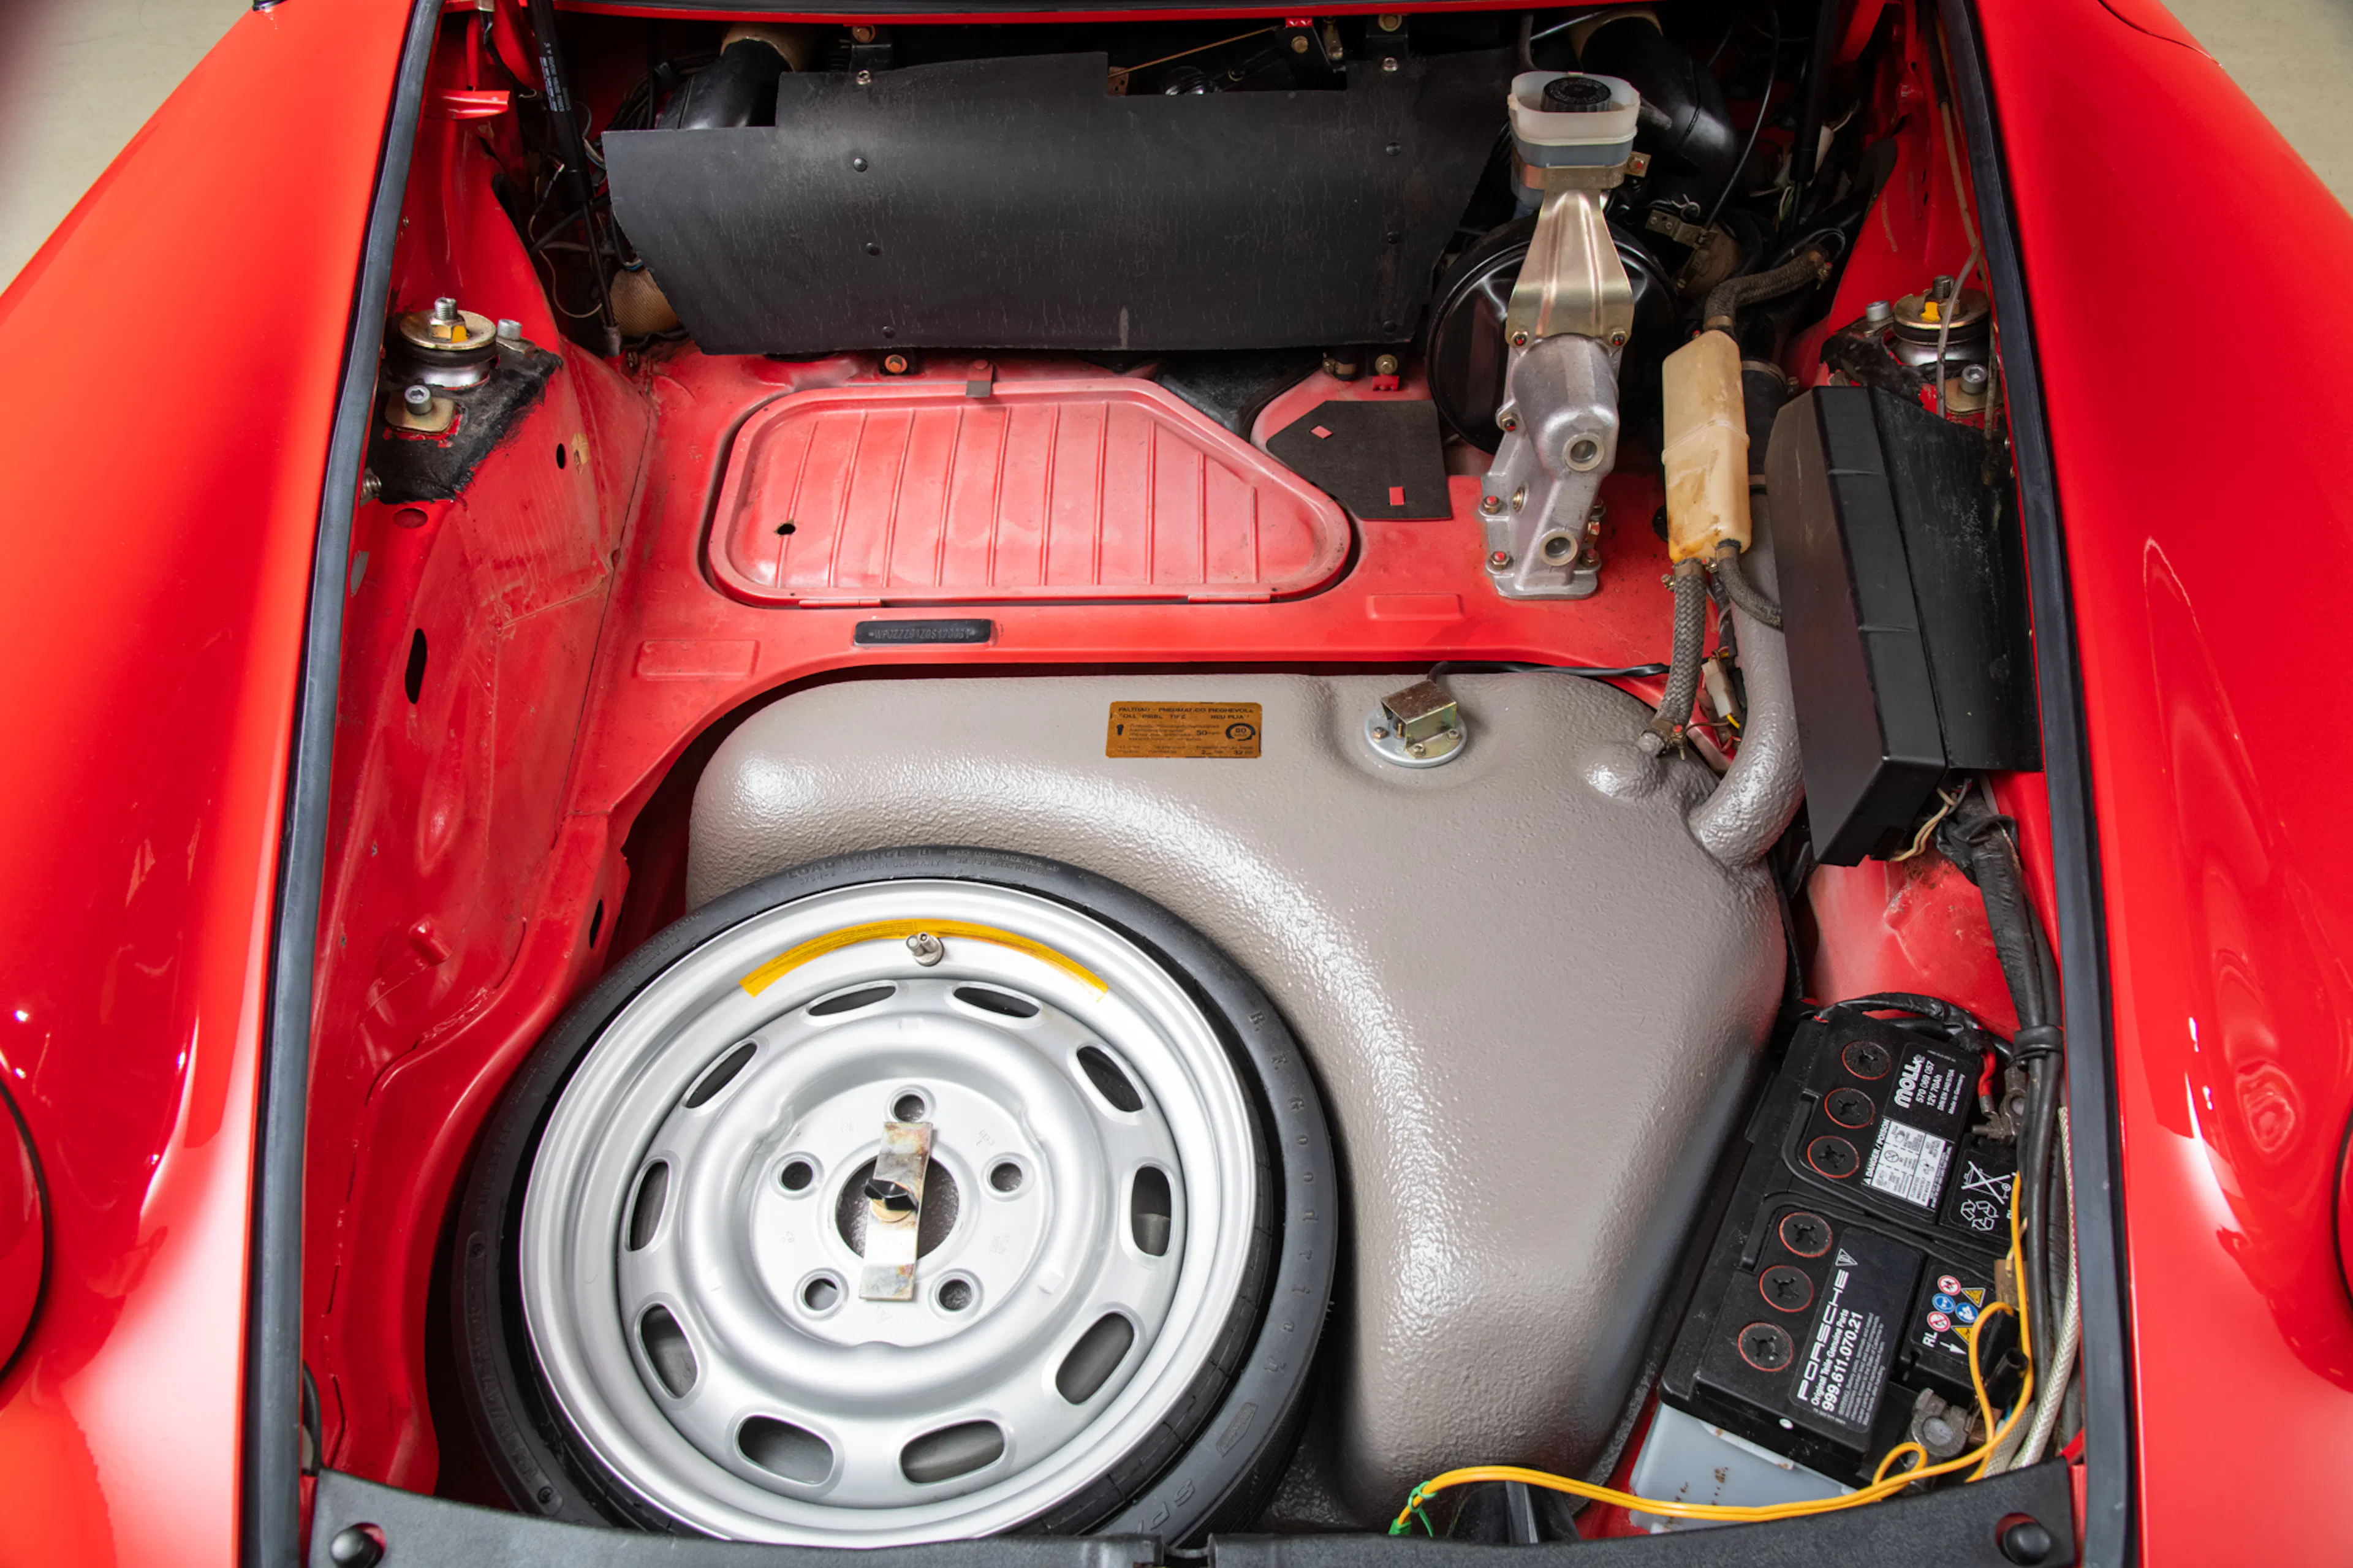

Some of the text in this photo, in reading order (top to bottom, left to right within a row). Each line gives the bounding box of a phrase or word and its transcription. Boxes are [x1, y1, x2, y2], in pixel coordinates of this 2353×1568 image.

[787, 861, 836, 879] LOAD
[1915, 1089, 1927, 1103] 570
[1927, 1075, 1942, 1106] 12V 70Ah
[1948, 1100, 1957, 1114] Made
[1953, 1074, 1965, 1095] Germany
[1866, 1149, 1880, 1177] DANGER
[1876, 1118, 1890, 1145] POISON
[1797, 1270, 1849, 1401] PORSCHE
[1923, 1332, 1938, 1347] RL
[1811, 1375, 1827, 1406] Original
[1827, 1328, 1843, 1358] Genuine
[1836, 1309, 1849, 1328] Parts
[1822, 1312, 1863, 1412] 999.611.070.21
